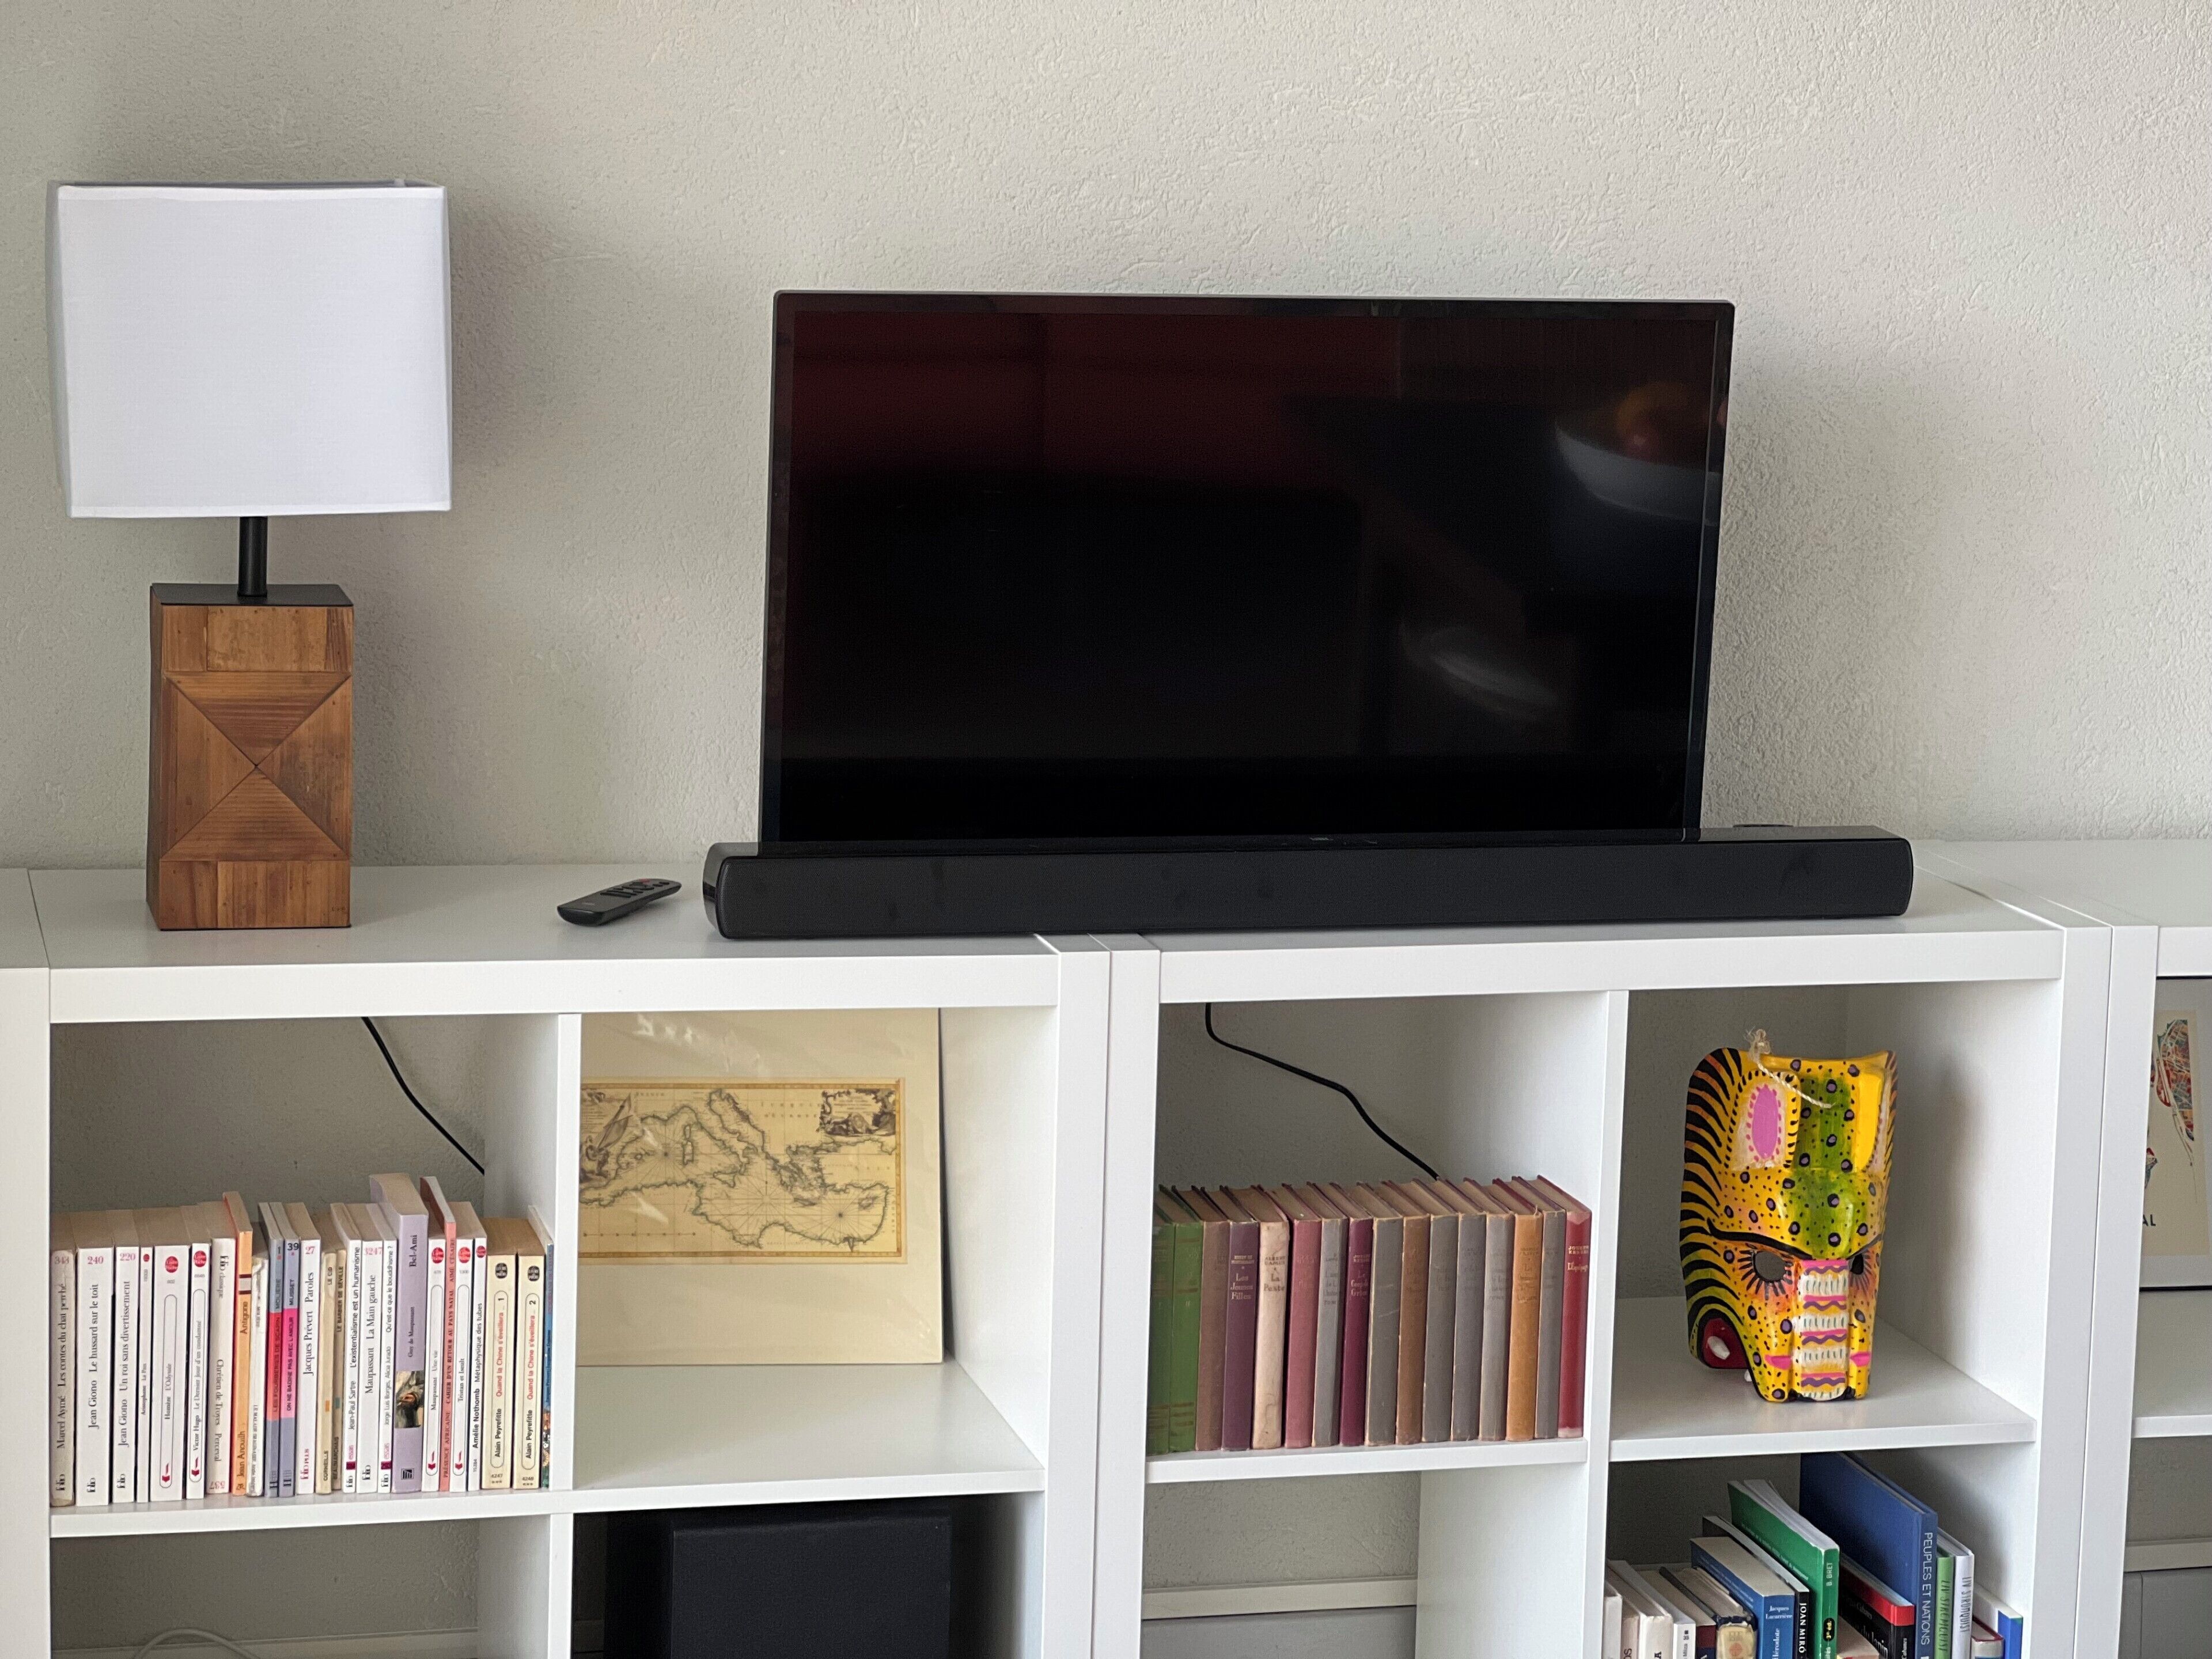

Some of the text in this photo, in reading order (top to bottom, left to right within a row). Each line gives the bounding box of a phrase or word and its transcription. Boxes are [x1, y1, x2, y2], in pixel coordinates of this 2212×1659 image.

[287, 1243, 299, 1251] 39
[305, 1246, 315, 1255] 27
[409, 1234, 418, 1267] Bel-Ami
[88, 1256, 104, 1265] 240
[351, 1247, 360, 1287] humanisme
[1271, 1274, 1280, 1282] La
[90, 1284, 99, 1298] toit
[353, 1290, 359, 1298] un
[1232, 1291, 1251, 1300] Filles
[89, 1301, 99, 1309] le
[120, 1281, 130, 1342] divertissement
[58, 1313, 66, 1330] chat
[303, 1272, 315, 1376] Jacques Prévert Paroles
[58, 1332, 66, 1343] du
[349, 1312, 358, 1368] L'existentialisme
[448, 1328, 453, 1336] AU
[89, 1326, 98, 1359] hussard
[274, 1344, 280, 1354] DE
[88, 1361, 97, 1372] Le
[474, 1336, 483, 1382] Métaphysique
[120, 1364, 128, 1376] roi
[361, 1275, 378, 1480] folio Maupassant La Main gauche
[58, 1373, 66, 1387] Les
[119, 1378, 128, 1391] Un
[88, 1380, 97, 1407] Giono
[236, 1301, 249, 1478] Jean Anouilh Antigone
[287, 1393, 292, 1401] NE
[58, 1396, 67, 1419] Aymé
[118, 1399, 127, 1426] Giono
[214, 1359, 224, 1462] Chrétien de Troyes Perceval
[287, 1402, 292, 1411] ON
[88, 1409, 100, 1429] Jean
[494, 1408, 502, 1439] Peyrefitte
[56, 1421, 66, 1449] Marcel
[118, 1427, 130, 1448] Jean
[1921, 1532, 1933, 1645] PEUPLES ET NATIONS
[1941, 1580, 1951, 1592] LIV
[1961, 1576, 1972, 1587] LIV
[1798, 1603, 1807, 1654] JOAN MIRÓ
